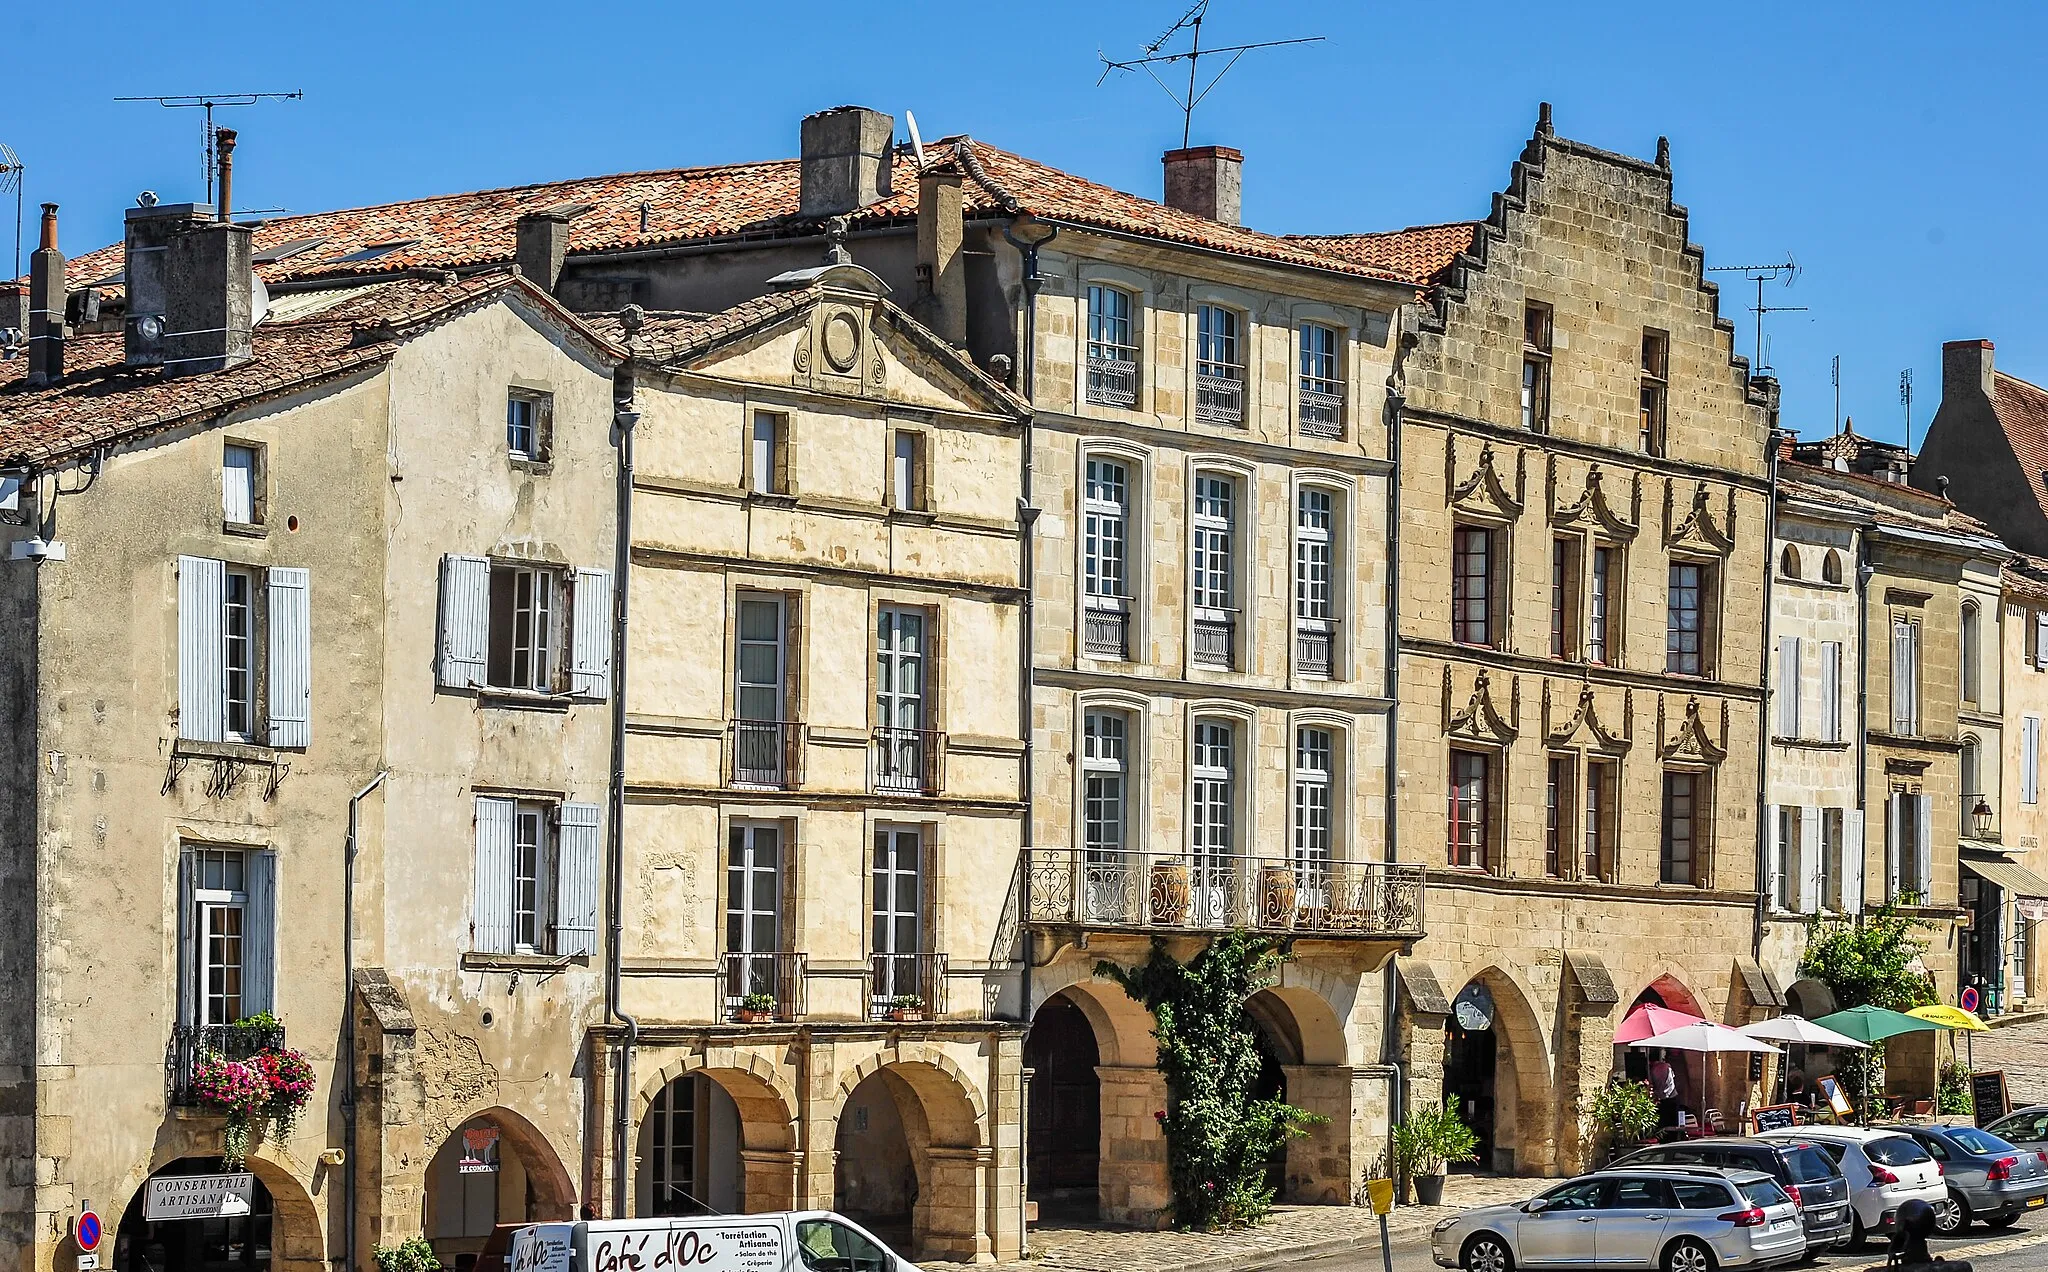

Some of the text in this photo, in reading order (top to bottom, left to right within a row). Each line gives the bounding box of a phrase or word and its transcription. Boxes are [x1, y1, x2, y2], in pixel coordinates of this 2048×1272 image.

[156, 1177, 247, 1193] CONSERVERIE
[159, 1193, 241, 1206] ARTISANALE
[720, 1230, 767, 1239] Torréfaction
[739, 1238, 778, 1248] Artisanale
[596, 1231, 718, 1272] Café d'Oc
